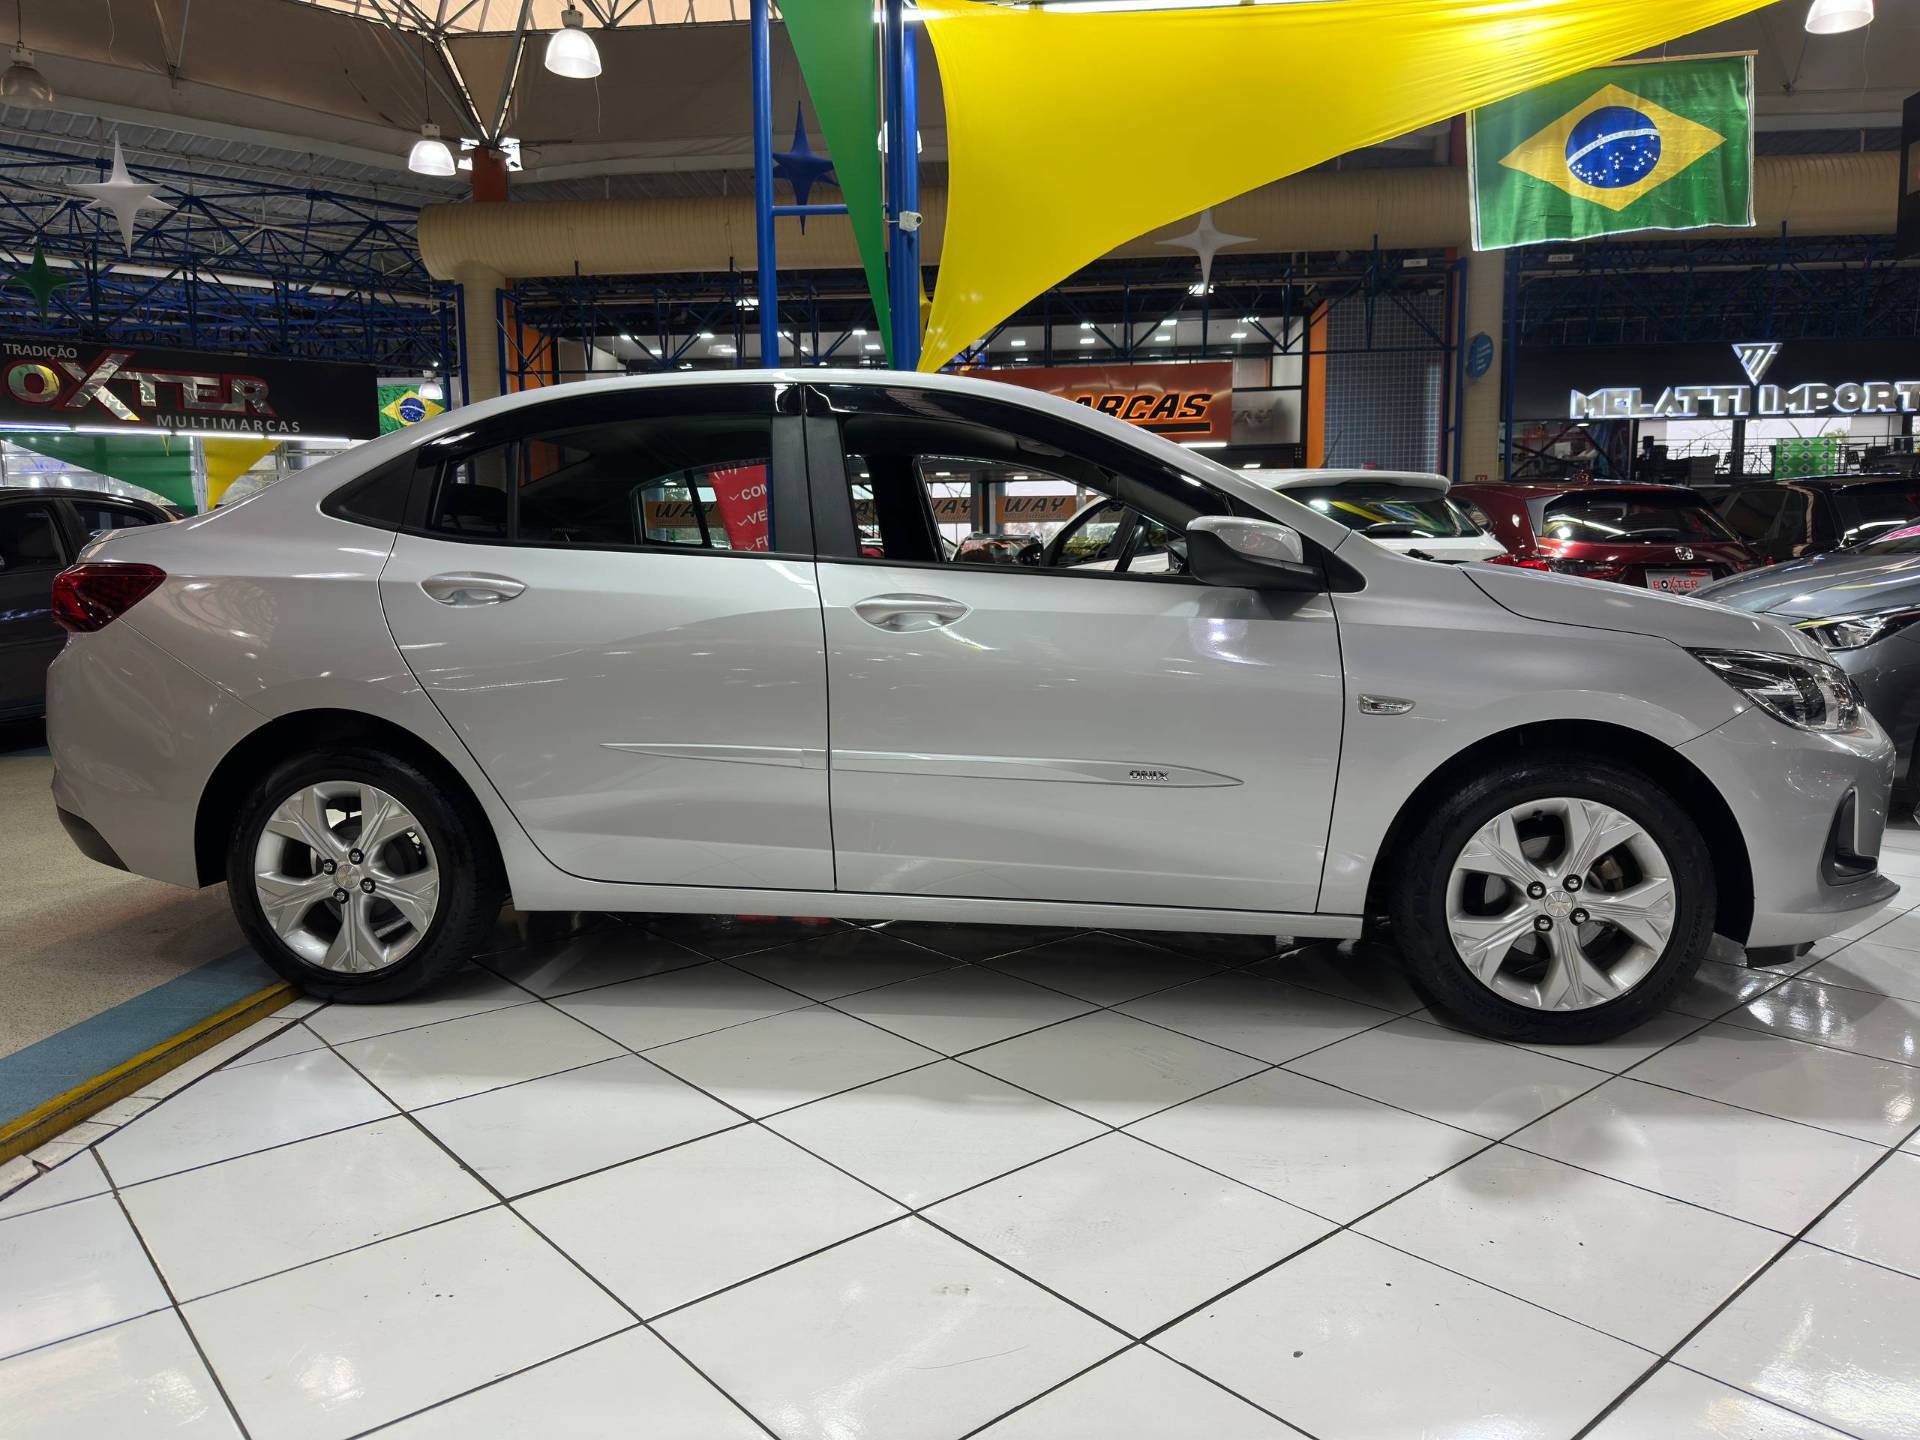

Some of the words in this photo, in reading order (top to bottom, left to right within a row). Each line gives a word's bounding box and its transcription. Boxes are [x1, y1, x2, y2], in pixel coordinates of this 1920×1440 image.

[2, 343, 78, 360] TRADIÇÃO
[1570, 386, 1751, 419] MELATTI
[156, 413, 301, 434] MULTIMARCAS
[1004, 497, 1066, 513] WAY
[1652, 575, 1698, 593] BOXTER
[1129, 770, 1168, 781] ONIX
